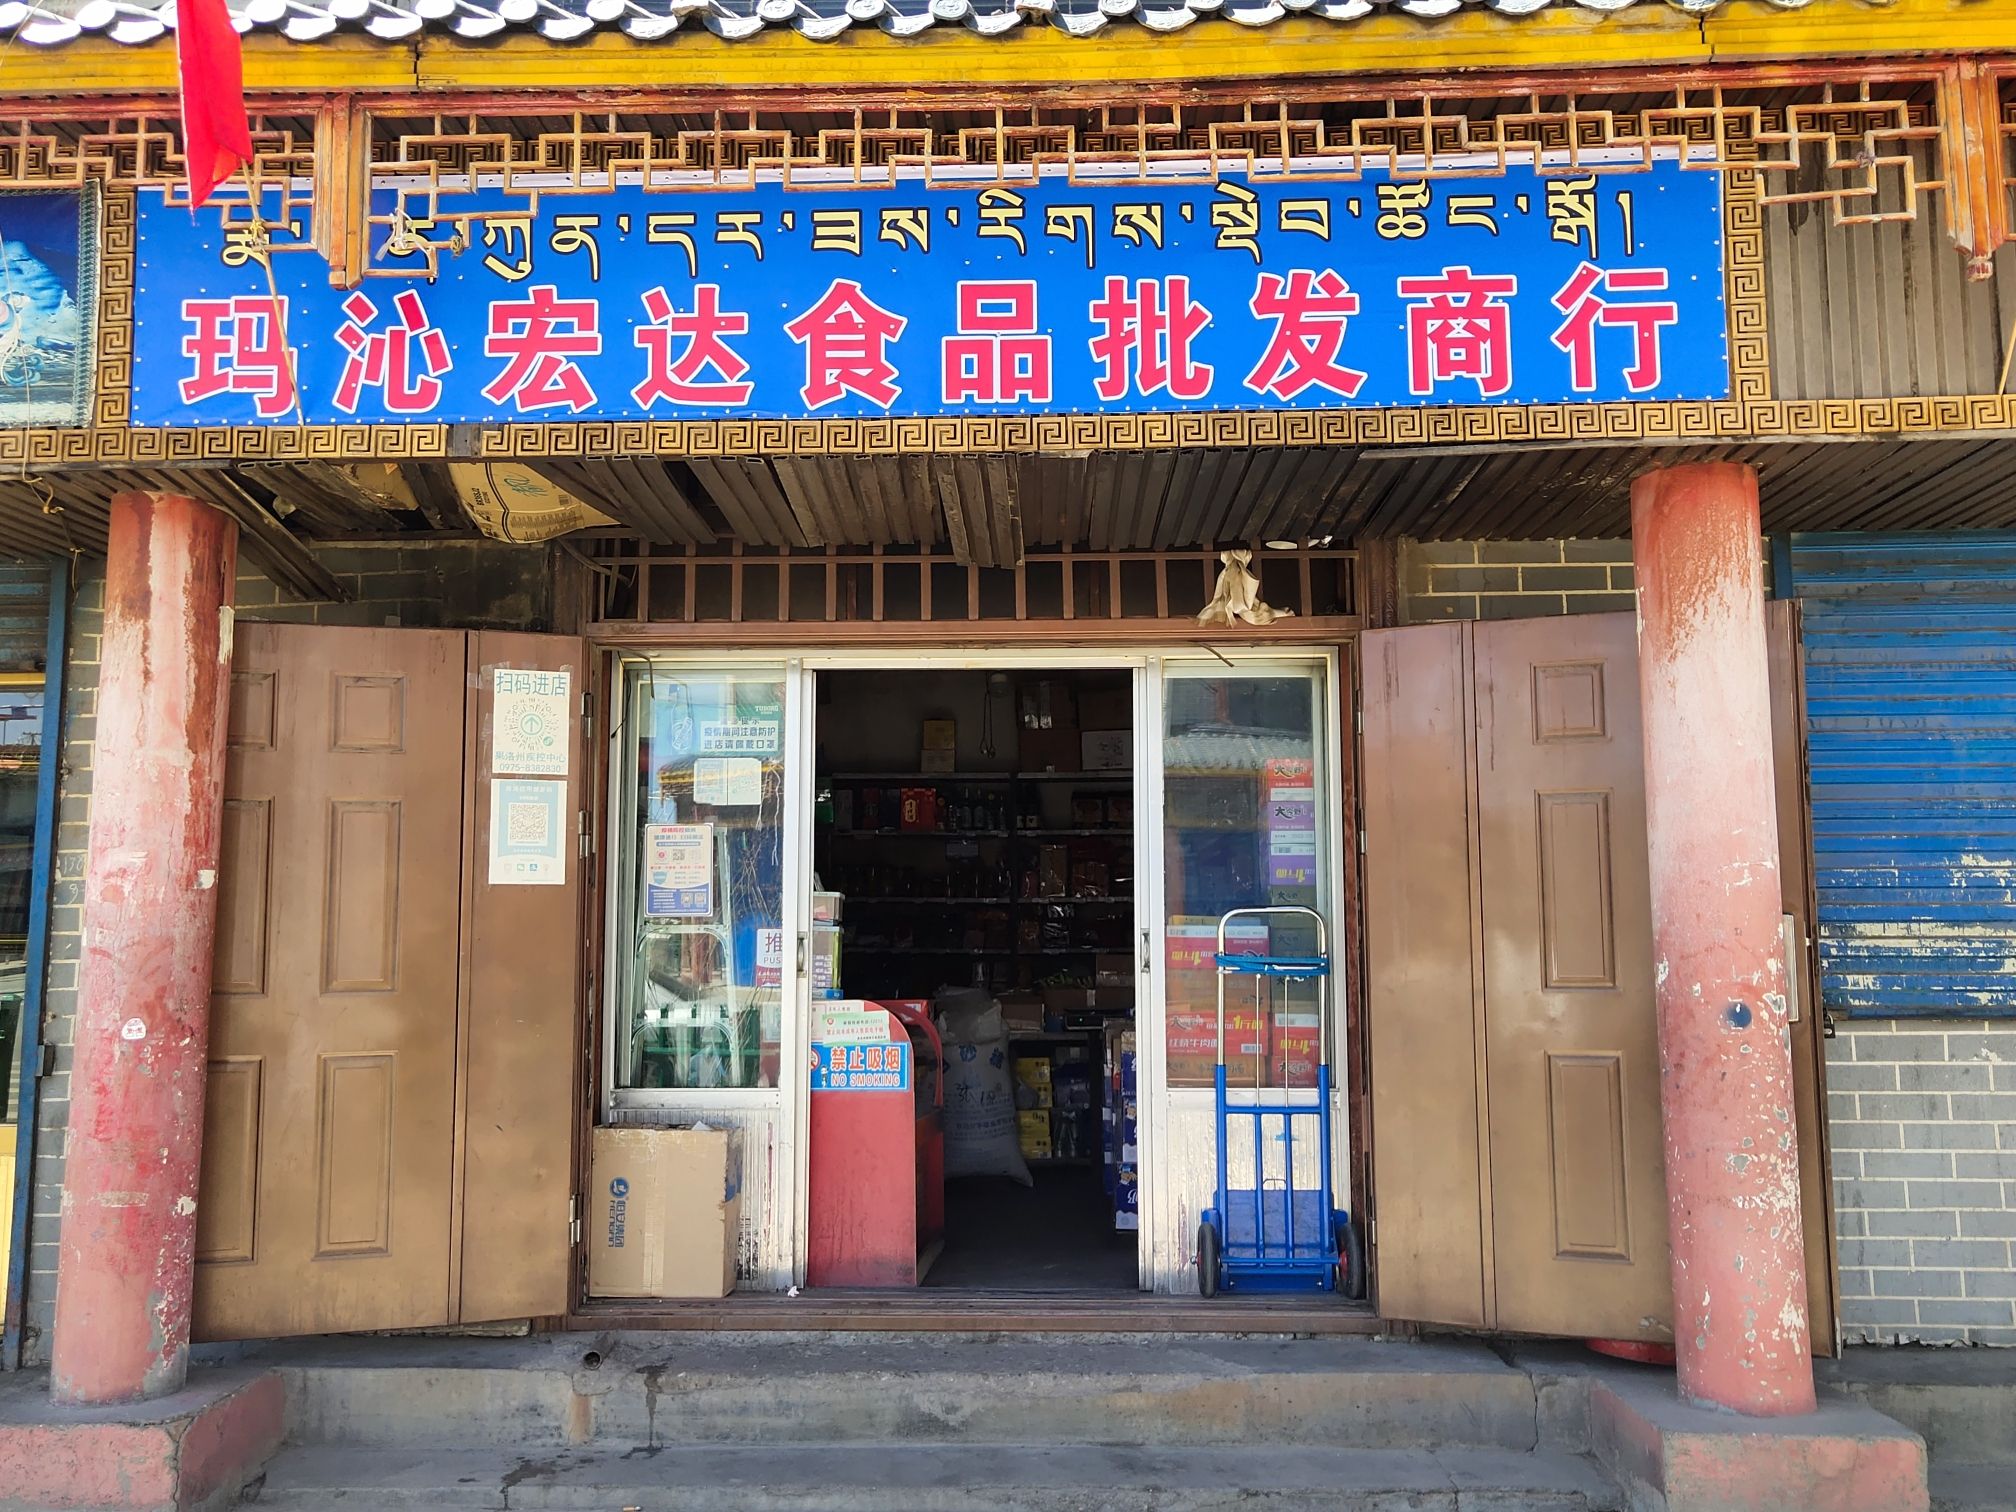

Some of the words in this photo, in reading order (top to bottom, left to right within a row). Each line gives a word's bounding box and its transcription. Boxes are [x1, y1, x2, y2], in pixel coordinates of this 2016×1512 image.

[178, 262, 1679, 418] 玛沁宏达食品批发商行
[496, 671, 567, 697] 扫码进店
[704, 727, 776, 737] 疫情期间注意防护
[704, 739, 775, 750] 进店请佩戴口罩
[765, 931, 783, 954] 推
[763, 956, 783, 965] PUS
[831, 1047, 901, 1071] 禁止吸烟
[831, 1073, 847, 1087] NO
[850, 1073, 900, 1087] SMOKING
